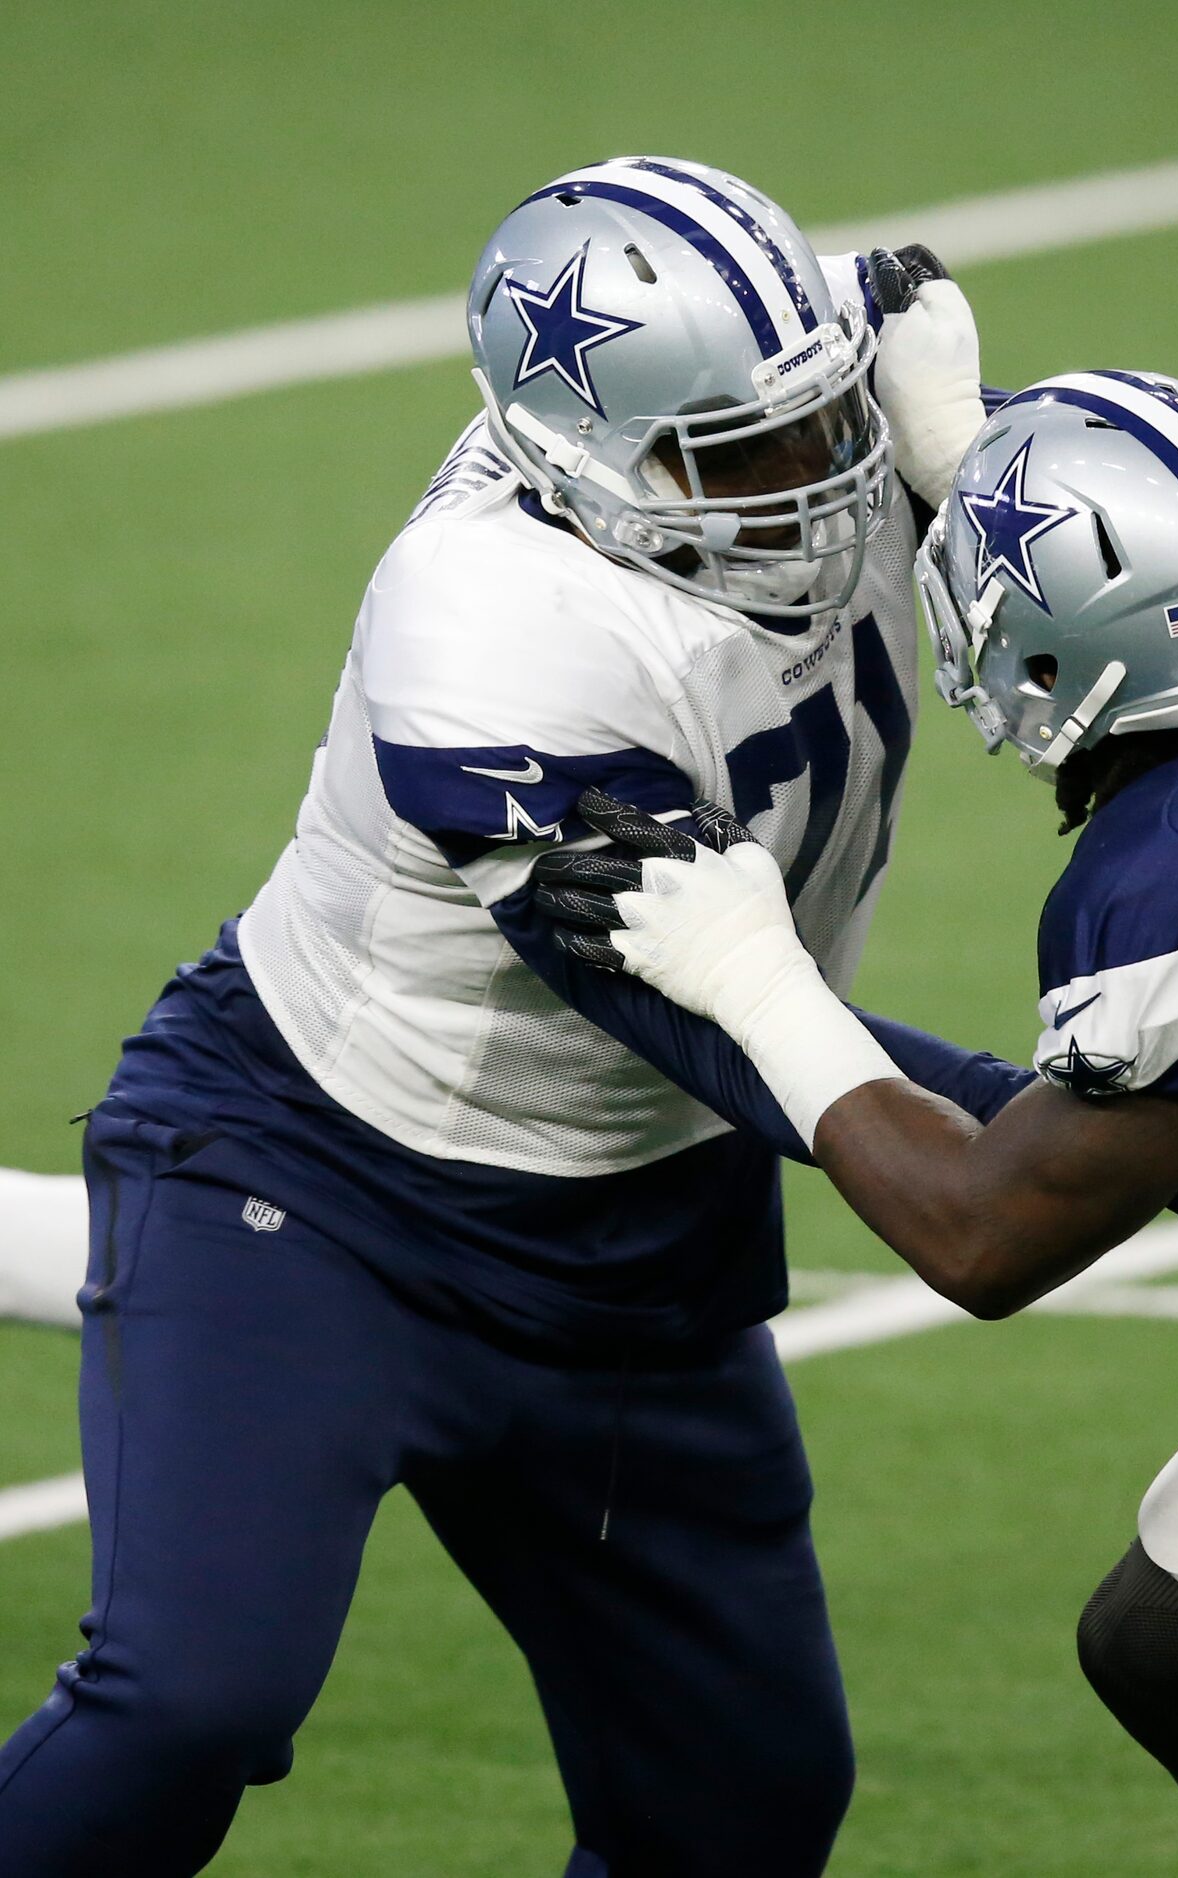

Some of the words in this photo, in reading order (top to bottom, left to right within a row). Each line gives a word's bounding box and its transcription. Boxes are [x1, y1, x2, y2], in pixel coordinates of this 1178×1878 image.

[777, 339, 823, 376] COWBOYS
[782, 616, 842, 686] COWBOYS
[248, 1203, 277, 1226] NFL
